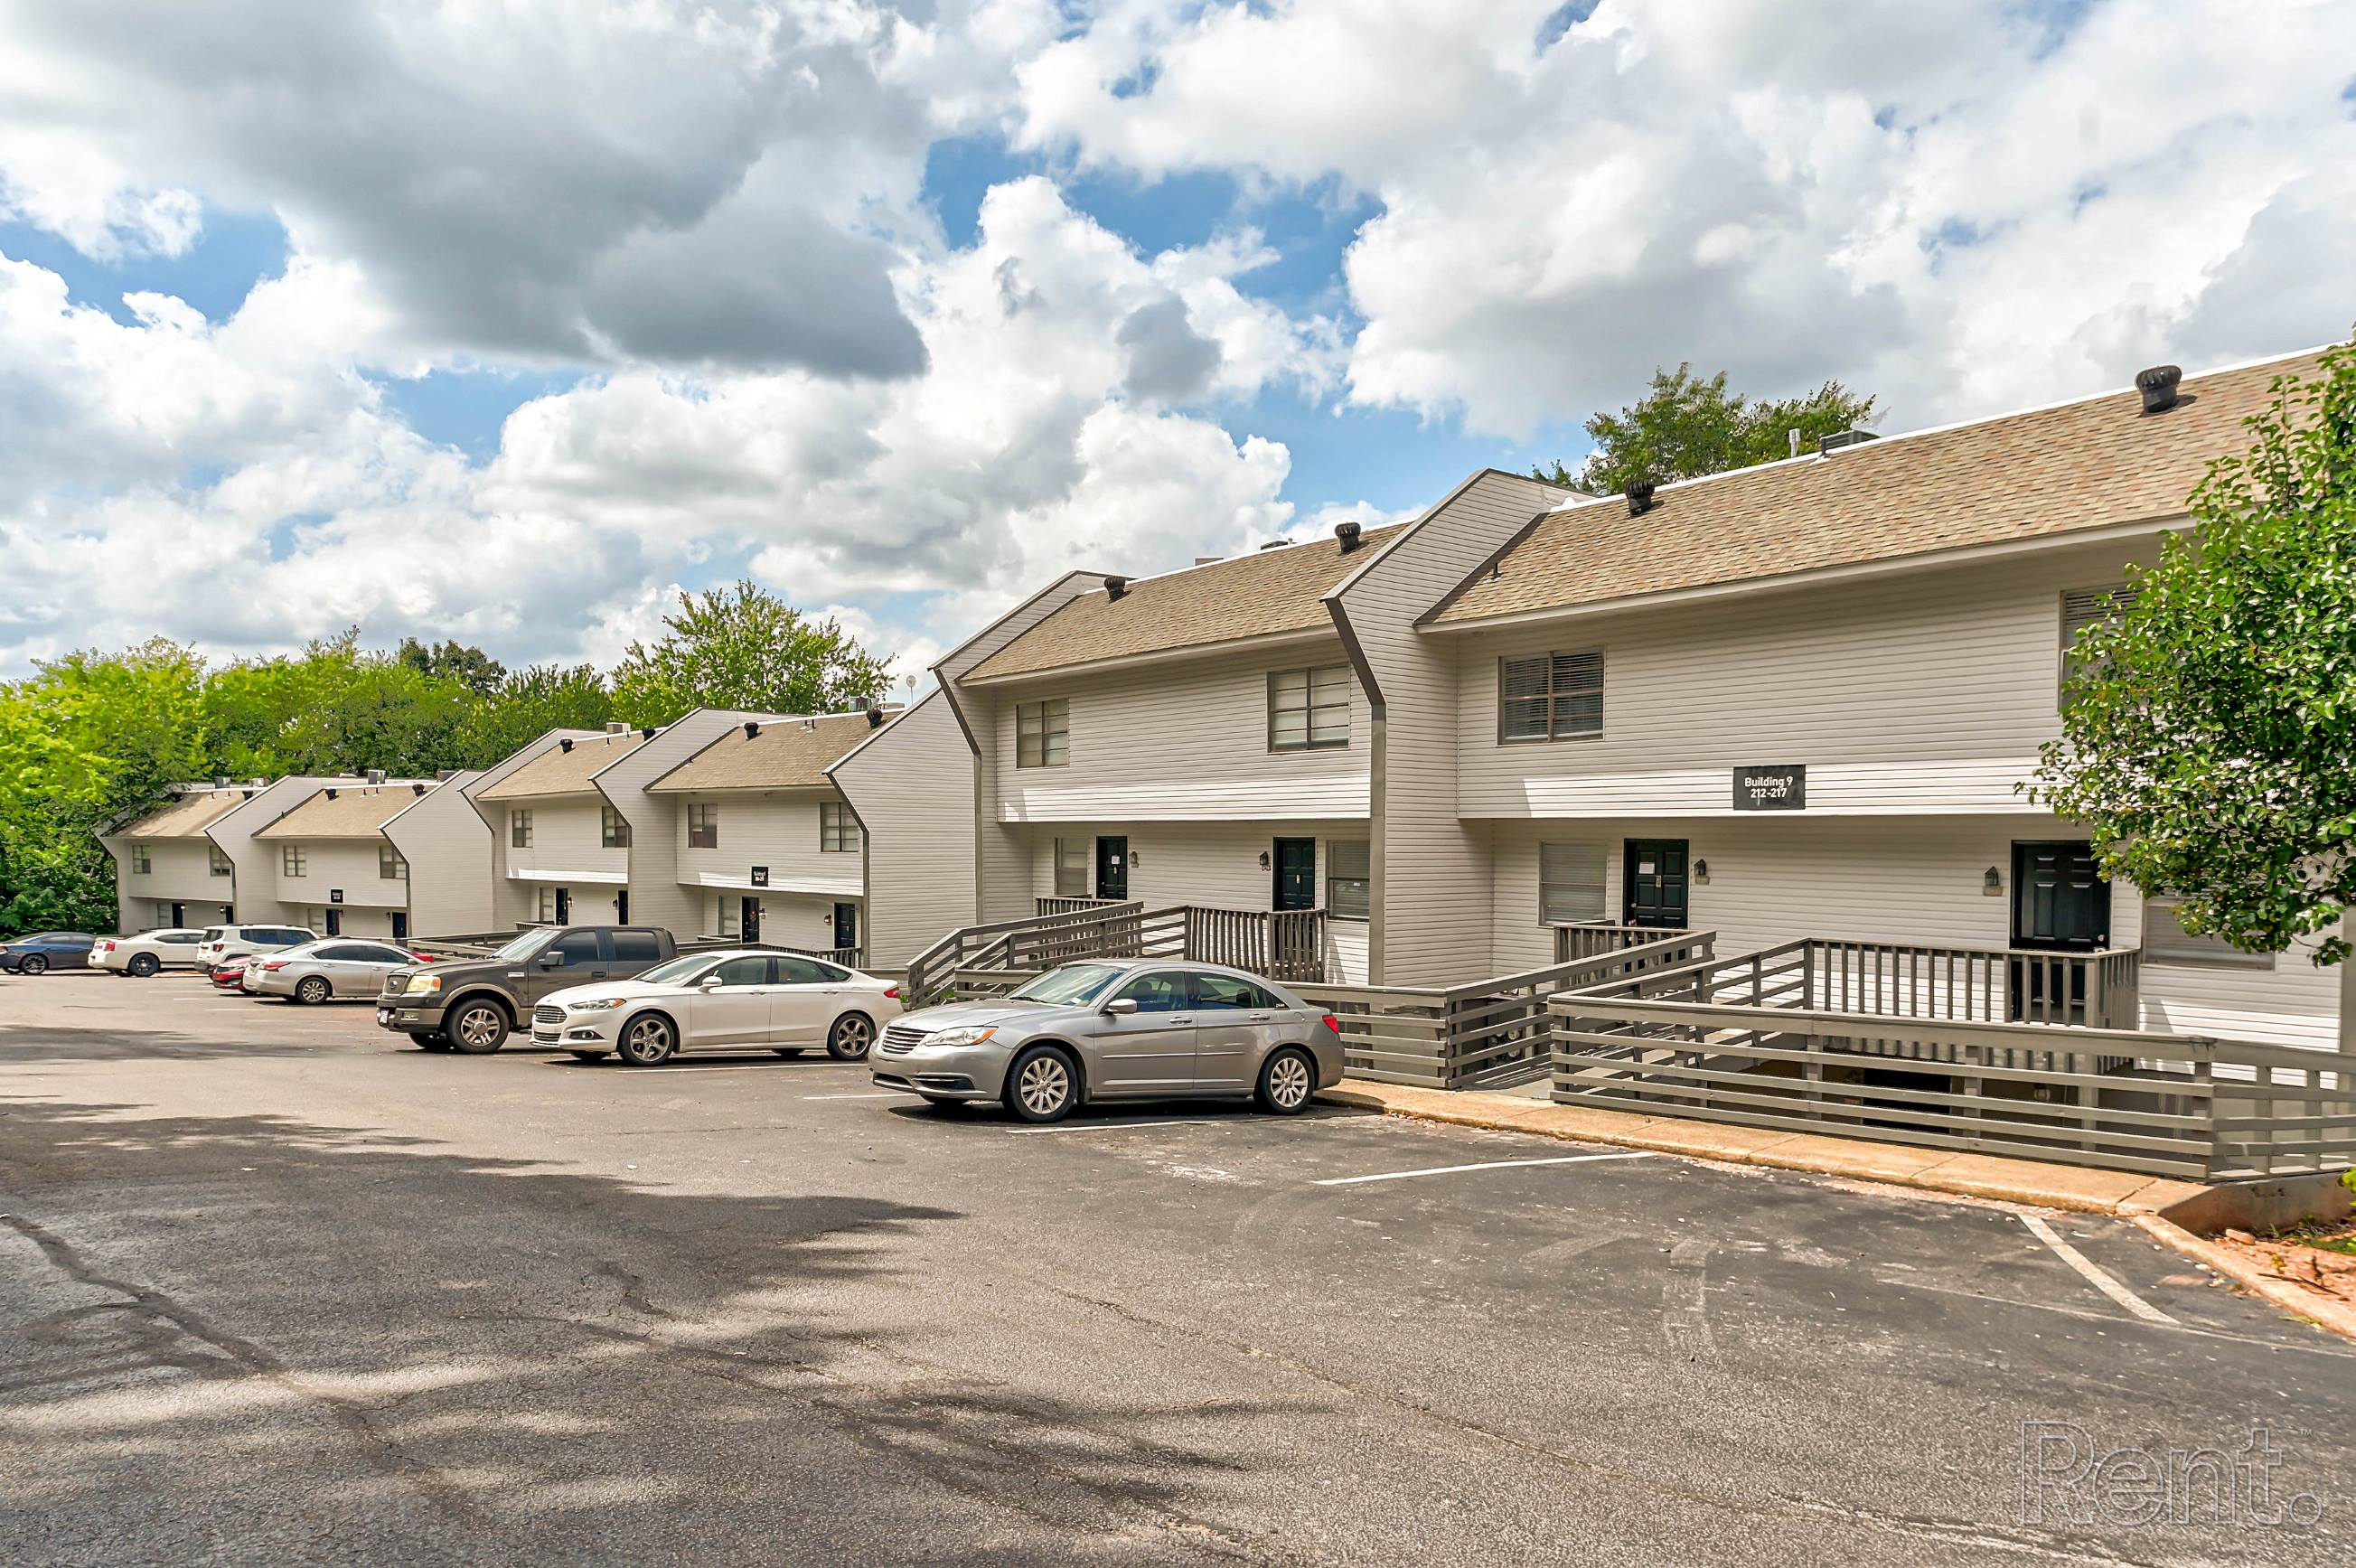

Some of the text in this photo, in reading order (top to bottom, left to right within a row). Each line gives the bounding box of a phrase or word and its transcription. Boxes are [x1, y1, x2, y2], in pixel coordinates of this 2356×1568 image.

[1744, 775, 1794, 788] Building 9
[1750, 787, 1788, 799] 212-217
